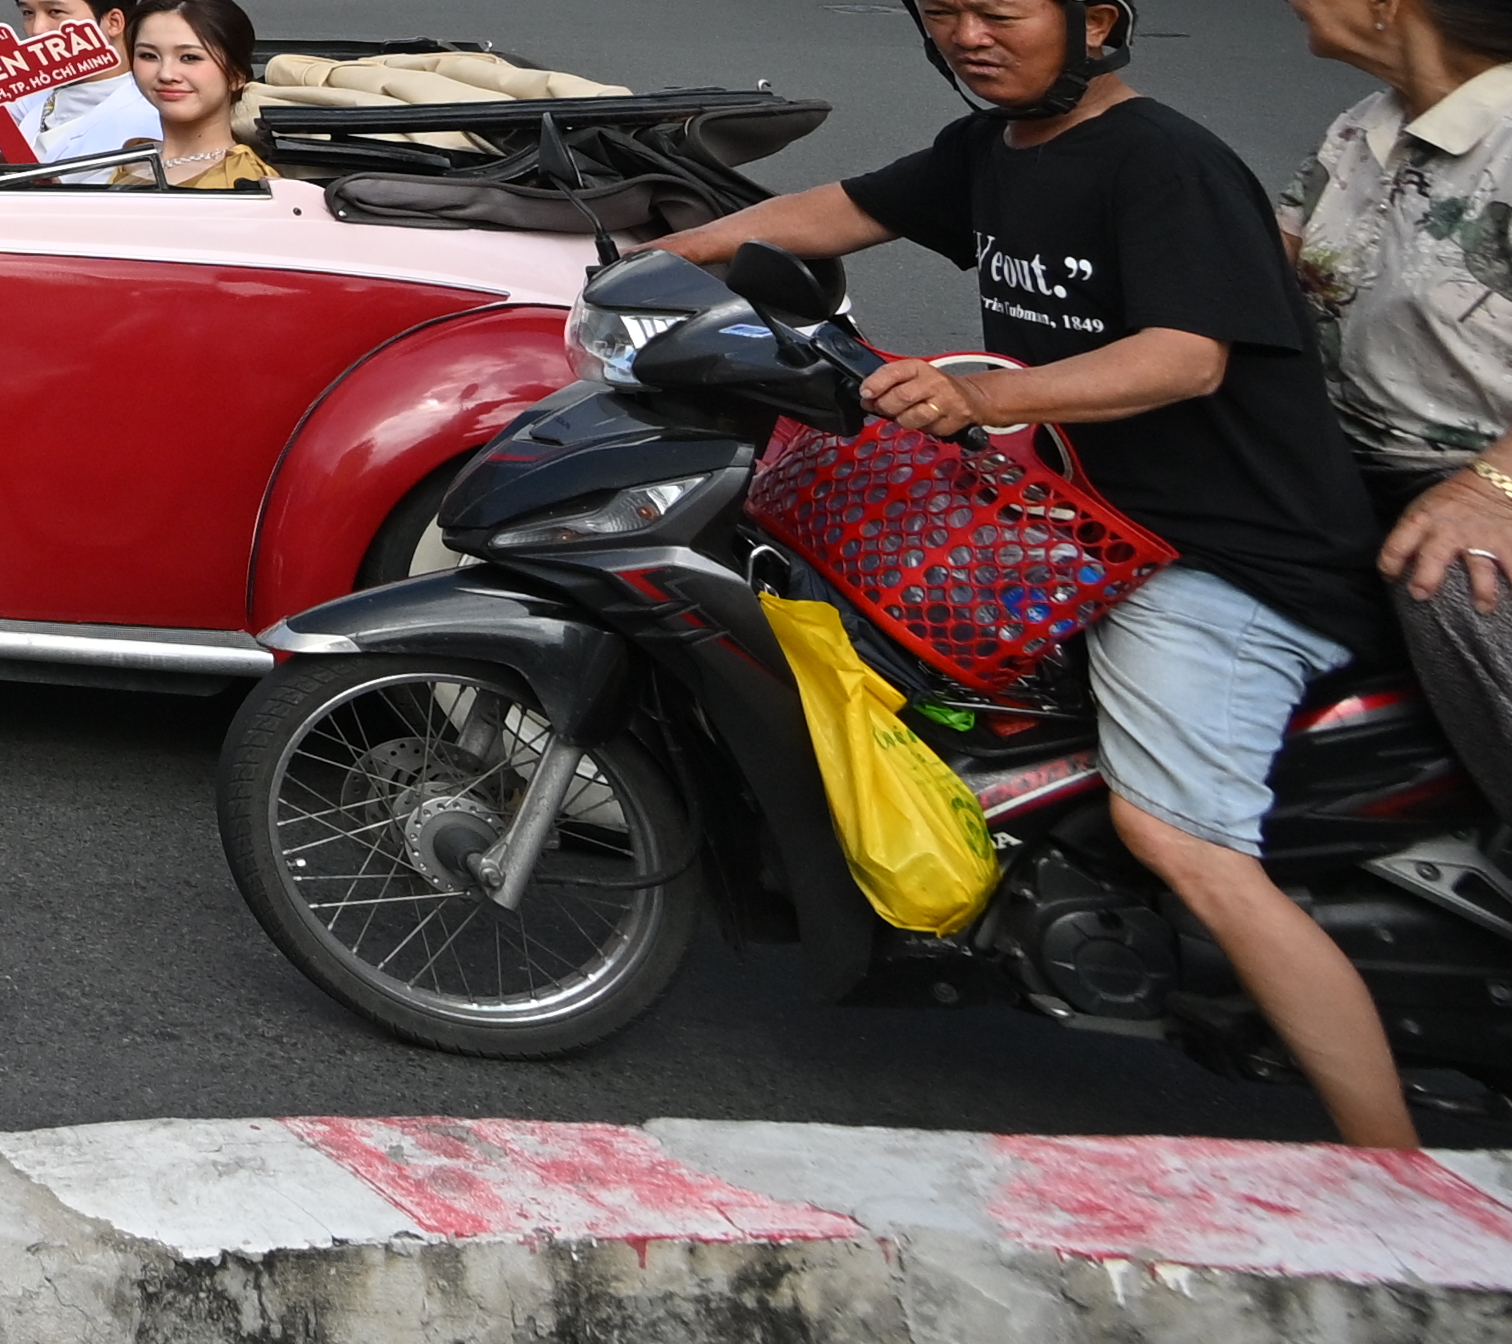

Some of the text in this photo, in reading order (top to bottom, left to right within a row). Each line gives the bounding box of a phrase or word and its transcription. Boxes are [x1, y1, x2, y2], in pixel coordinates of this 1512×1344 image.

[27, 25, 101, 66] TRÃI
[9, 81, 30, 97] TP.
[30, 71, 51, 89] HỒ
[52, 63, 77, 82] CHÍ
[77, 52, 113, 74] MINH
